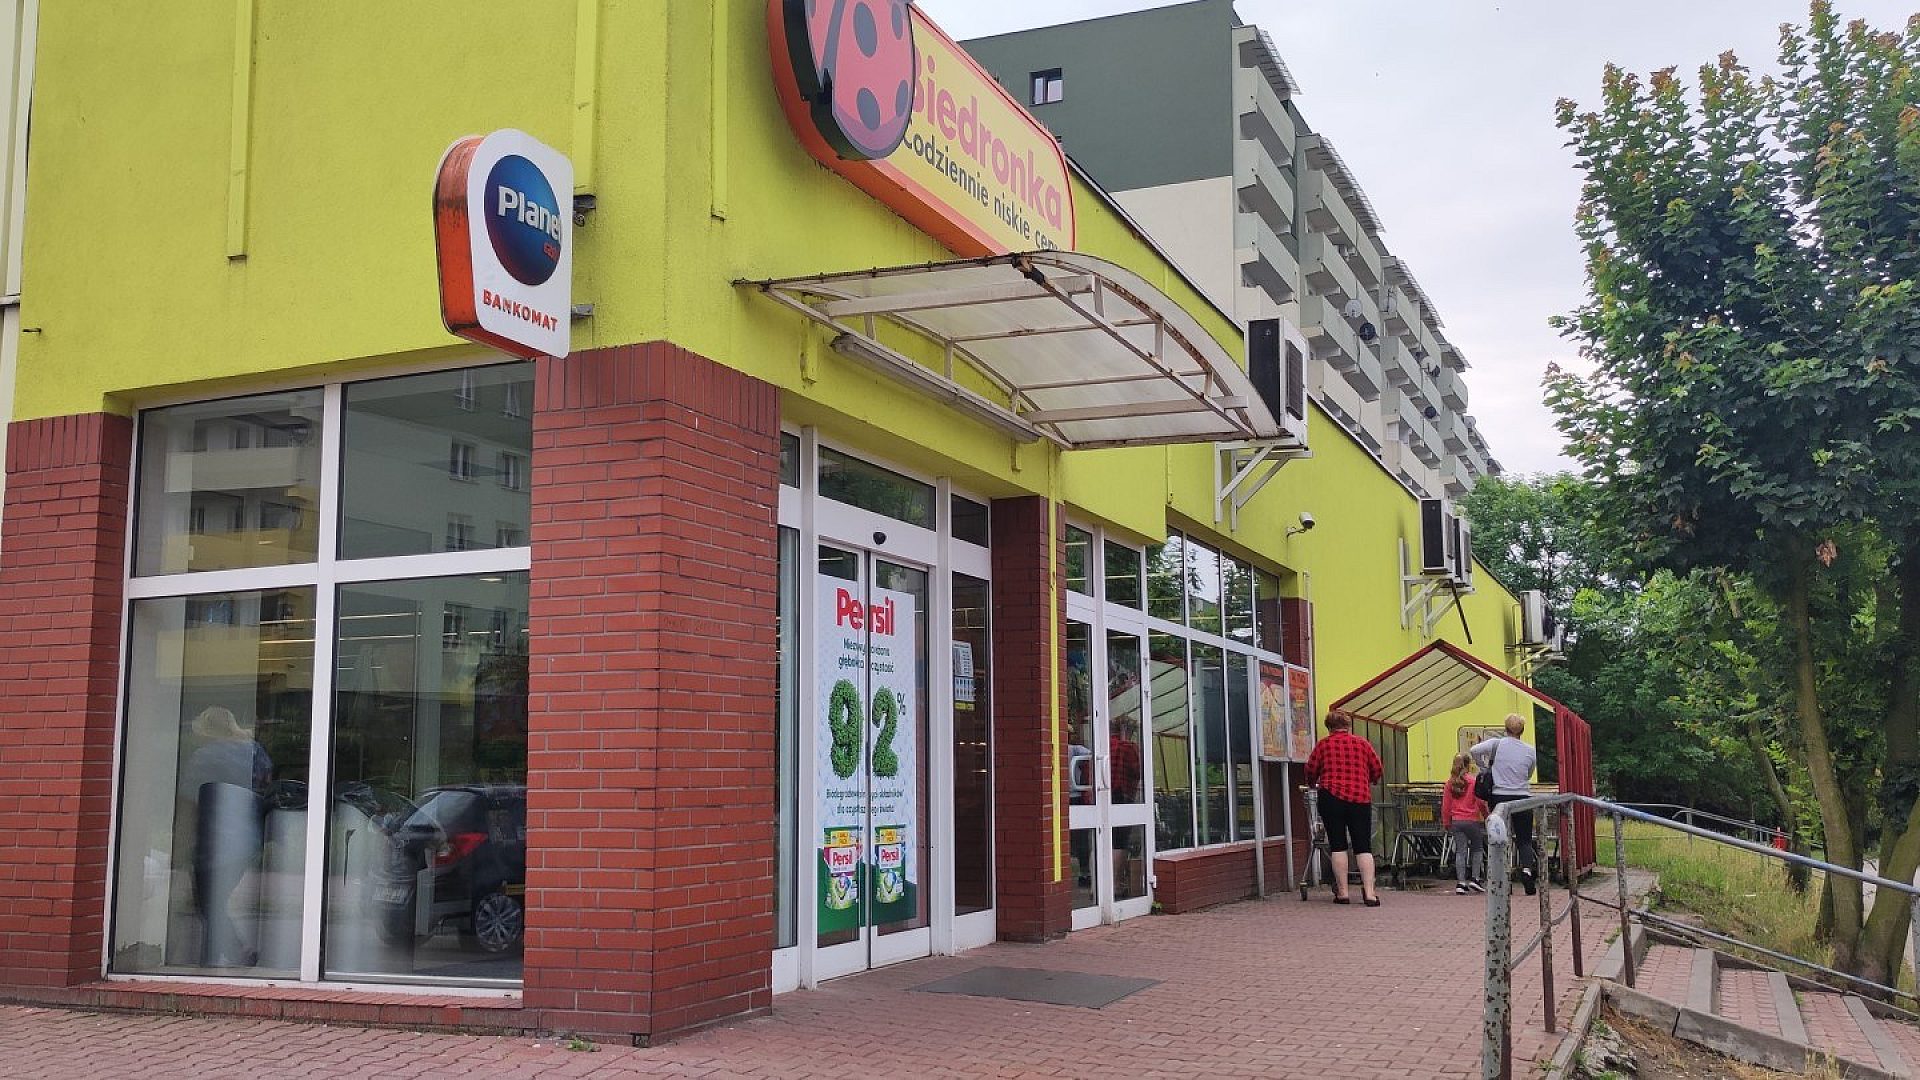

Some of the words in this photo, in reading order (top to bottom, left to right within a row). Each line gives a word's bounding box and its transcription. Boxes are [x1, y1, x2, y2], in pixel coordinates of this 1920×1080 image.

[498, 185, 562, 242] Plane
[994, 193, 1030, 241] niskie
[1035, 229, 1058, 250] cen
[483, 288, 559, 332] BANKOMAT
[836, 587, 894, 636] Persil
[832, 849, 852, 866] Persil
[881, 847, 899, 862] Persil
